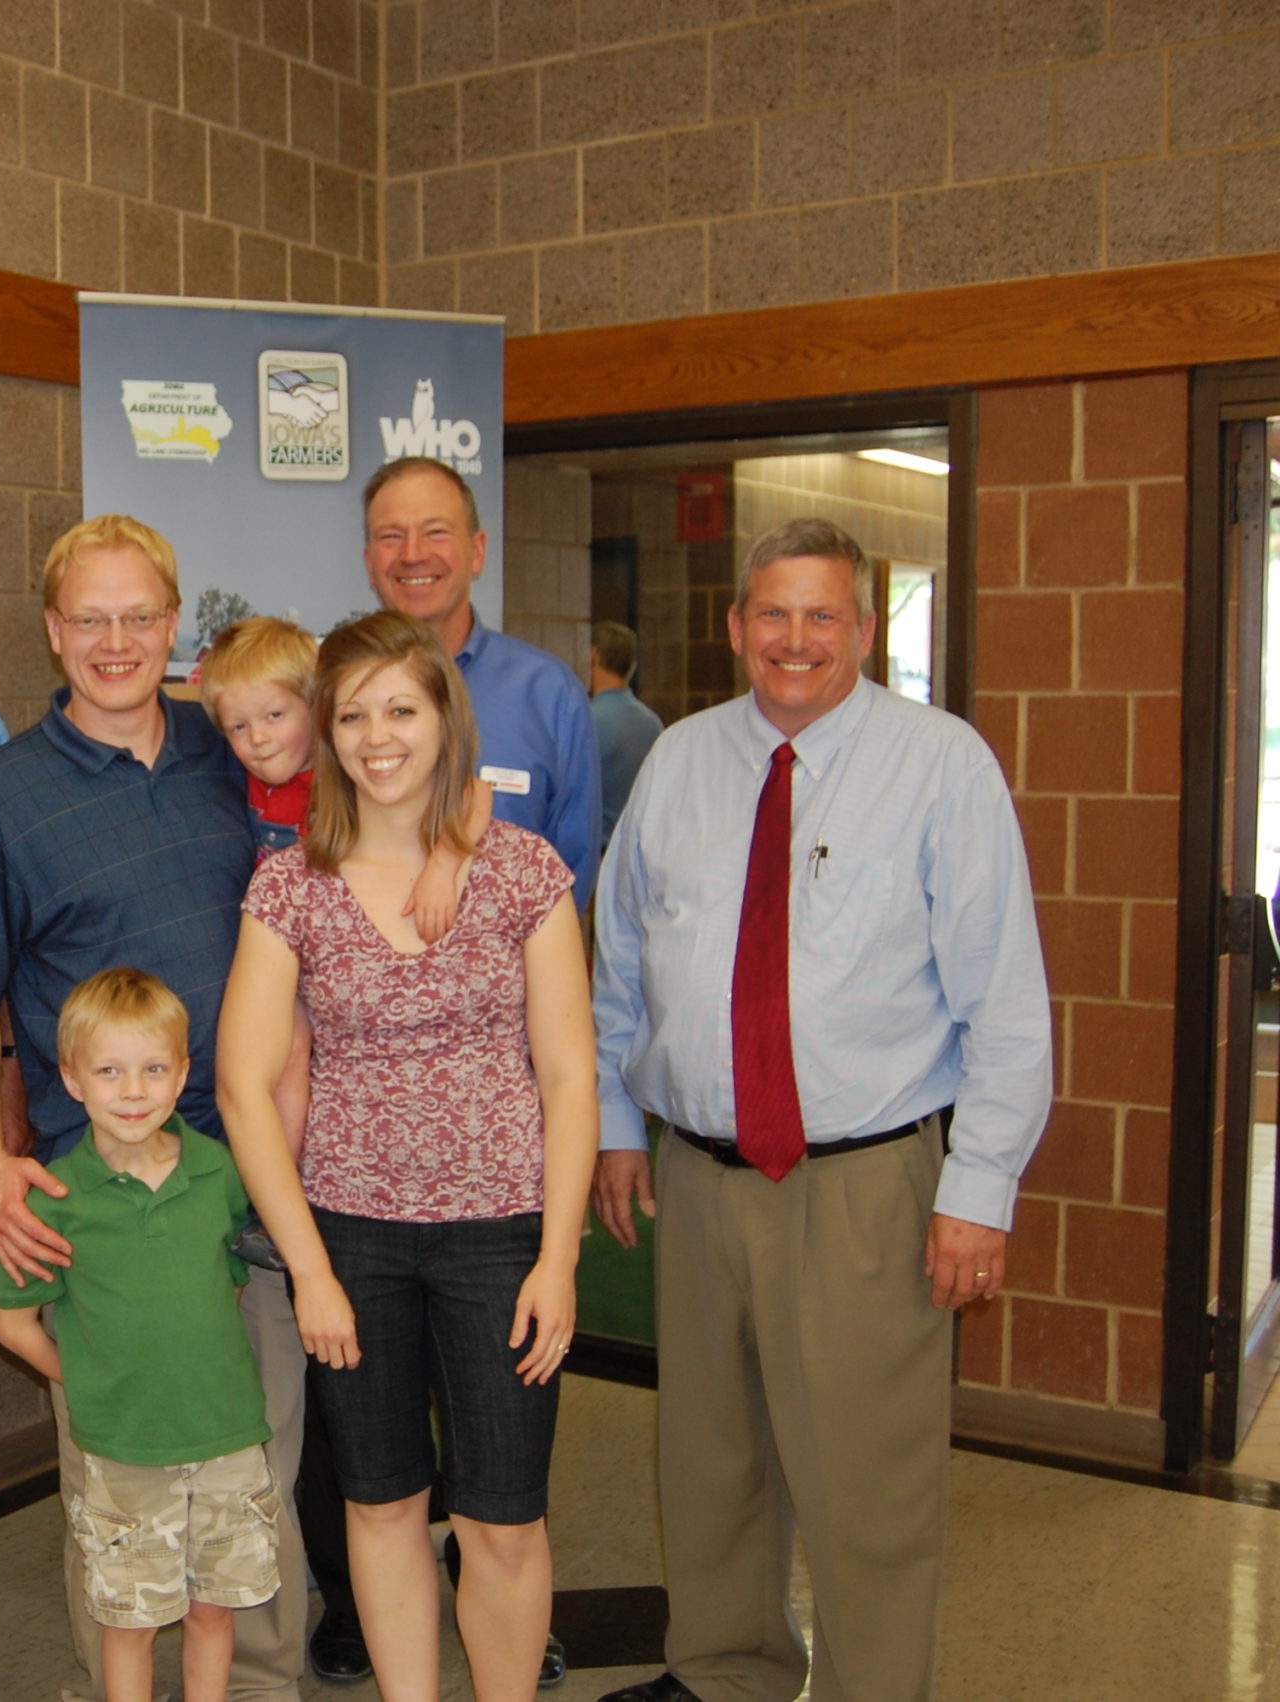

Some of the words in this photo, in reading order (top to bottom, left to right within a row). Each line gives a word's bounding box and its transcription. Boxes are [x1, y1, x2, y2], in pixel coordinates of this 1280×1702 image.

[130, 403, 219, 415] AGRICULTURE
[267, 422, 342, 444] IOWA'S
[379, 416, 481, 459] WHO
[269, 445, 343, 464] FARMERS
